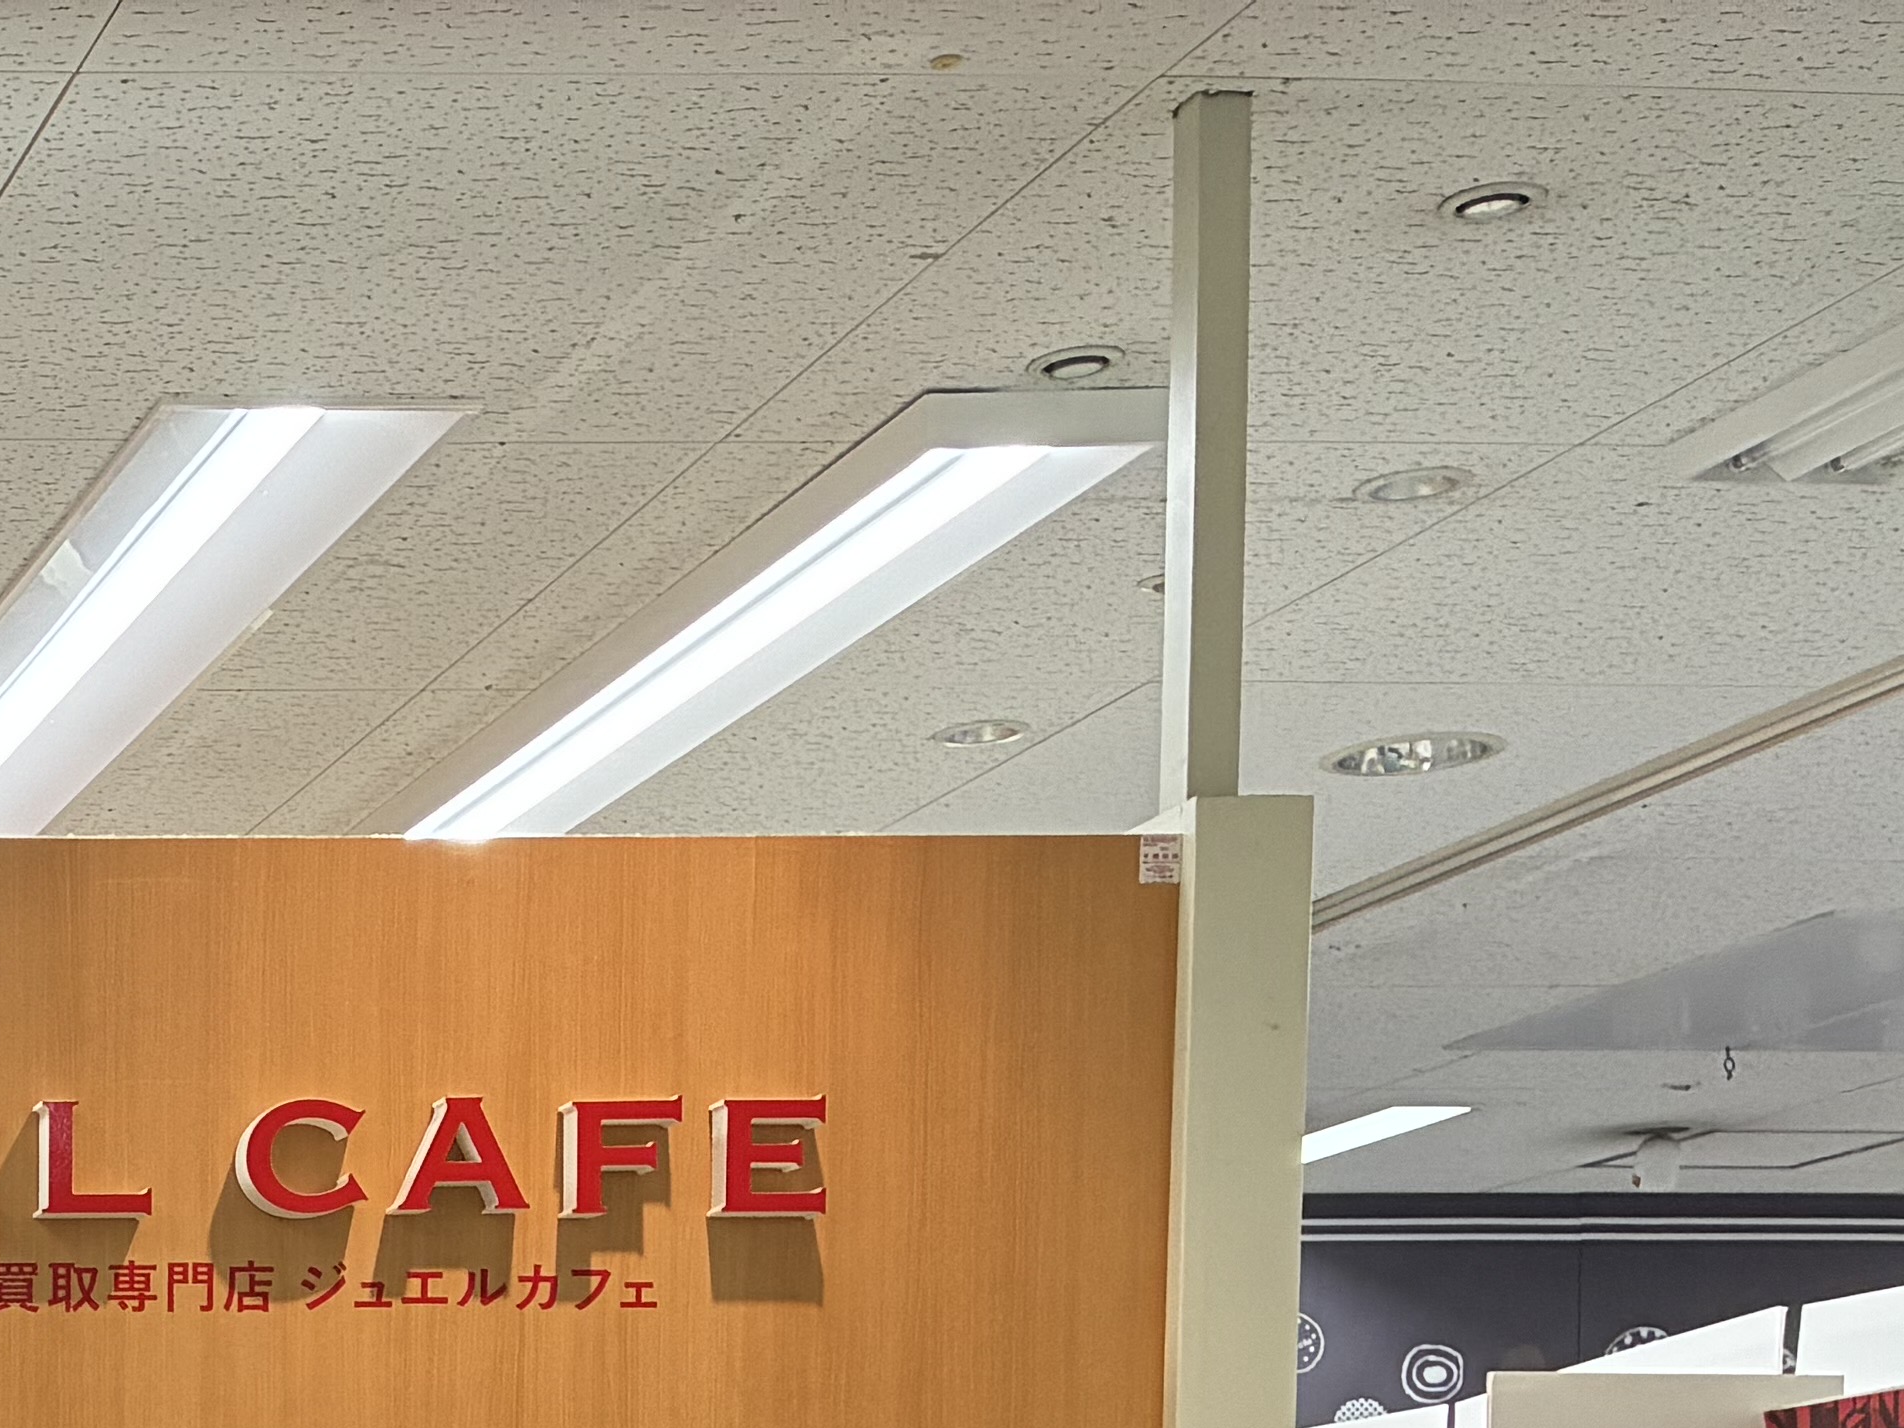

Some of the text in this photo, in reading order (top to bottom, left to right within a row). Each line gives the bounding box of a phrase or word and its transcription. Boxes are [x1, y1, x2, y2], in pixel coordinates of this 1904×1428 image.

[234, 1090, 832, 1222] CAFE
[300, 1264, 660, 1313] ジュエルカフェ
